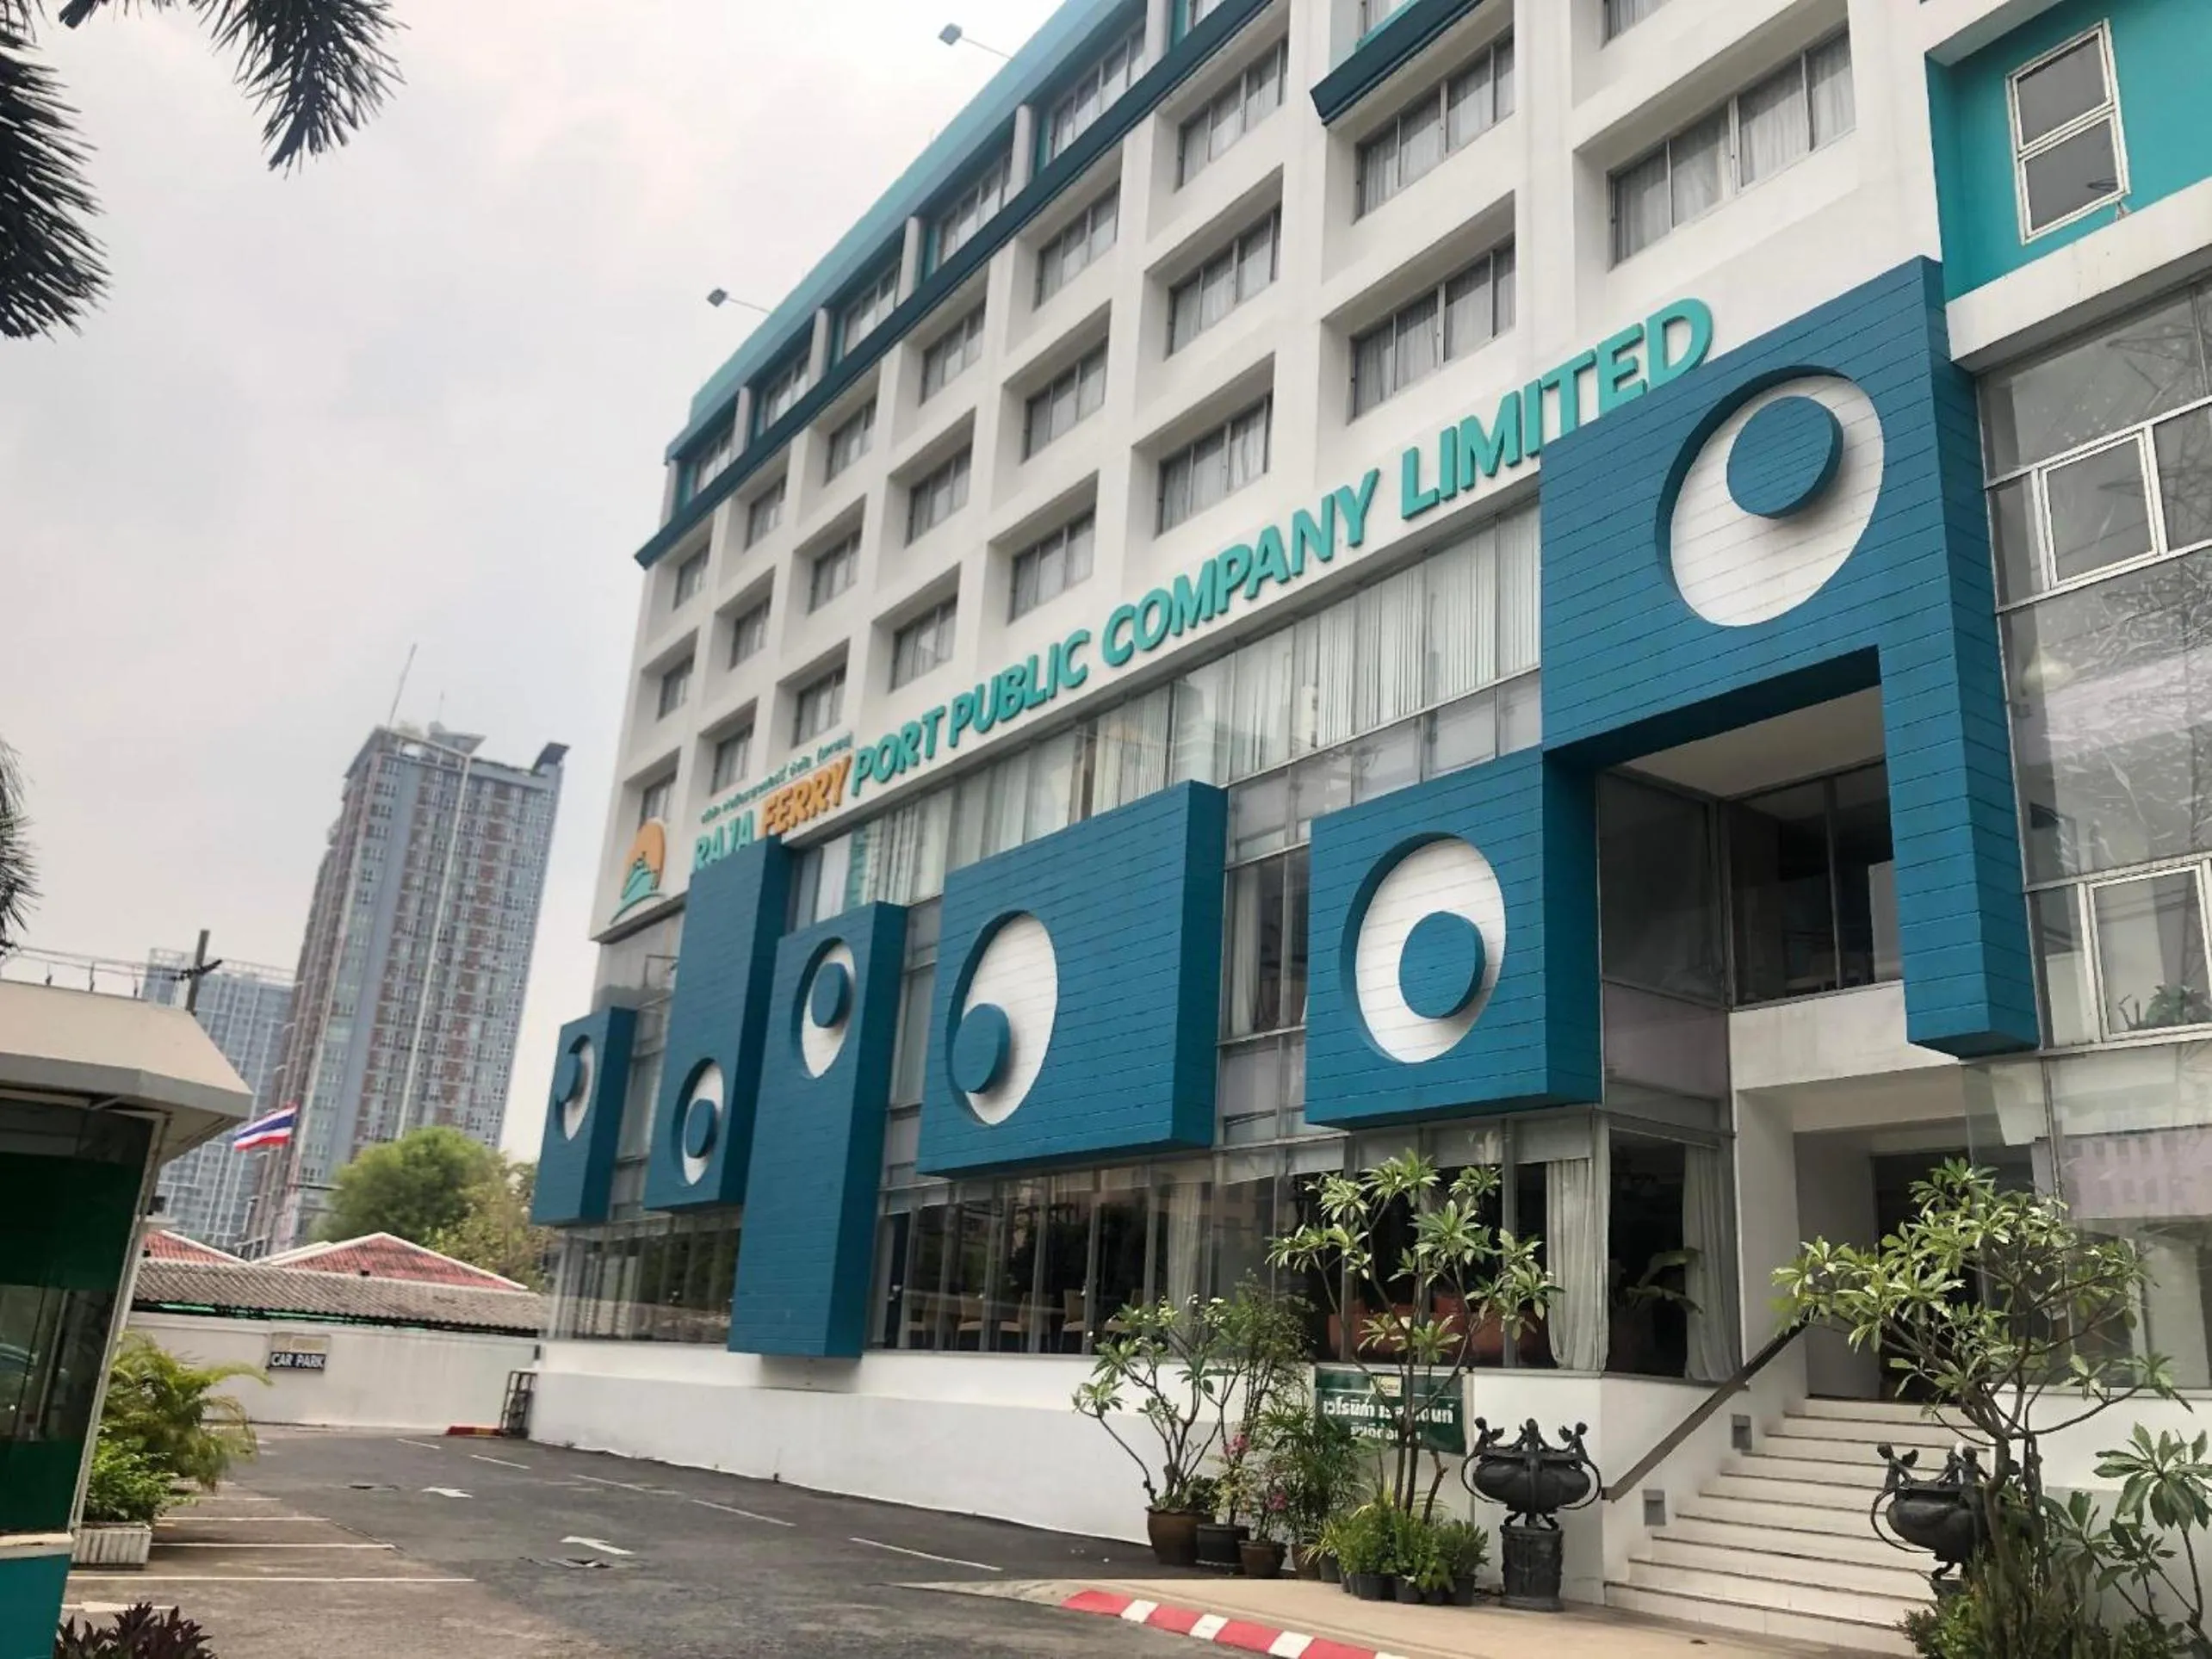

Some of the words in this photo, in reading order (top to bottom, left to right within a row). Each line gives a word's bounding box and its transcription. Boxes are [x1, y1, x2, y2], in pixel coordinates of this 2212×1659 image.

[696, 809, 755, 870] RAJA
[760, 755, 852, 837] FERRY
[851, 705, 945, 796] PORT
[948, 628, 1091, 748] PUBLIC
[1101, 468, 1380, 667] COMPANY
[1402, 298, 1713, 518] LIMITED
[271, 1353, 293, 1367] CAR
[295, 1354, 325, 1368] PARK
